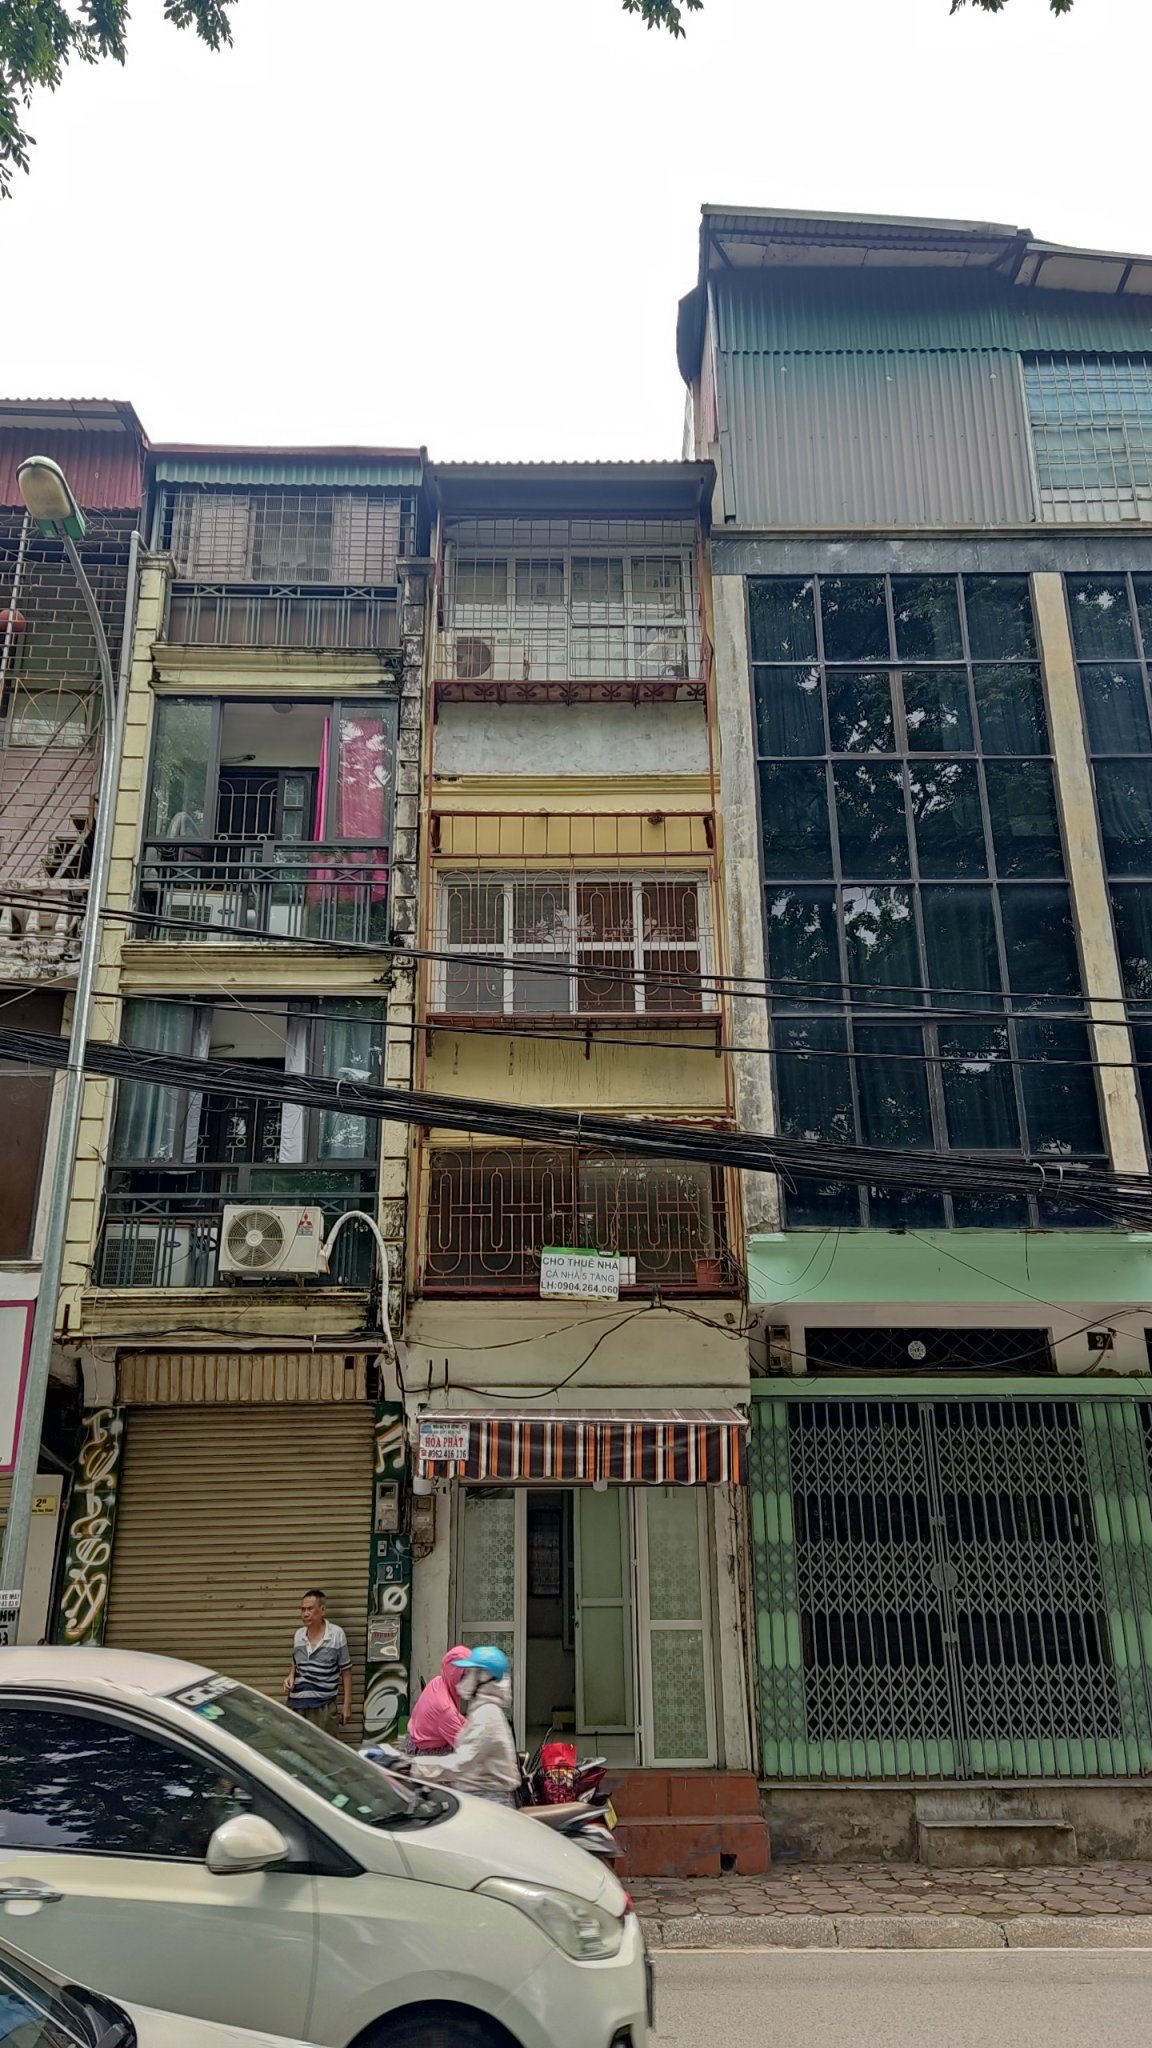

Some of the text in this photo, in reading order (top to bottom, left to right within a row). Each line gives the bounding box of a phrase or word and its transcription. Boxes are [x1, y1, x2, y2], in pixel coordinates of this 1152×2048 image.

[542, 1257, 619, 1270] CHO THUÊ NHÀ
[582, 1273, 588, 1281] 5
[541, 1281, 618, 1295] LH:0904.264.060
